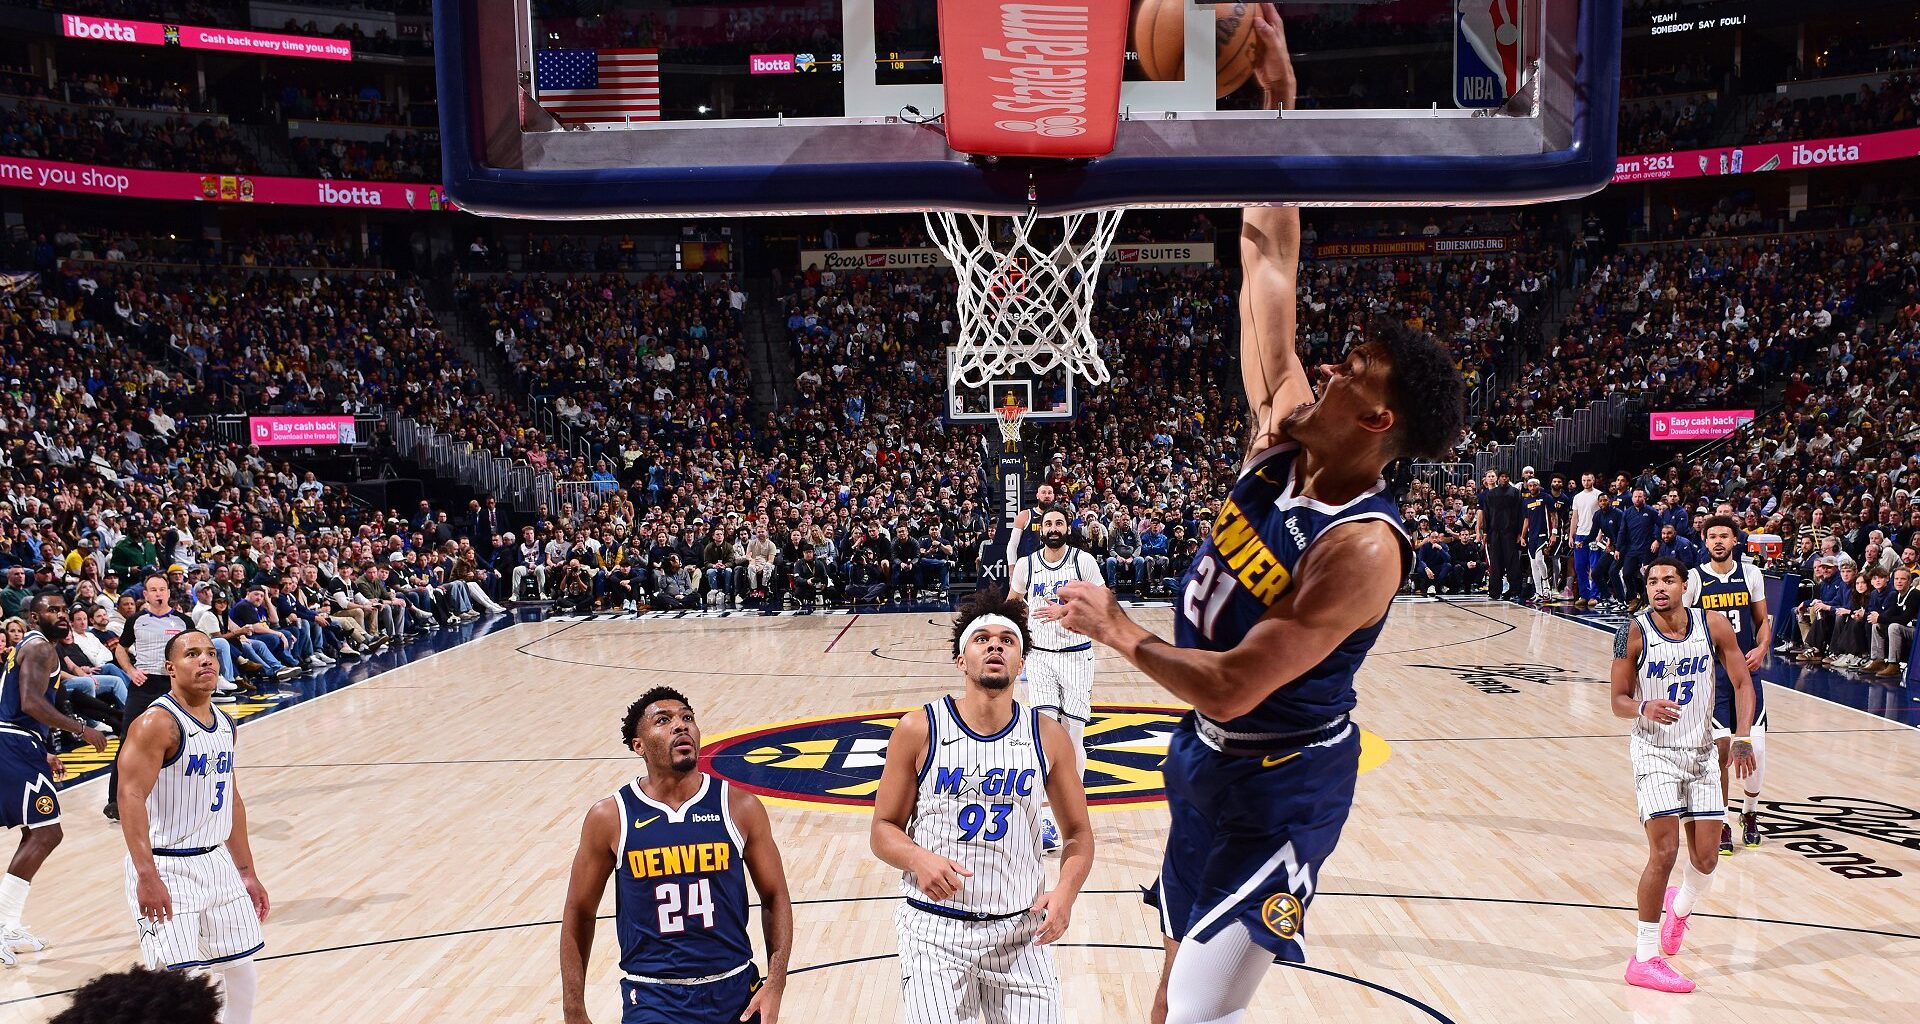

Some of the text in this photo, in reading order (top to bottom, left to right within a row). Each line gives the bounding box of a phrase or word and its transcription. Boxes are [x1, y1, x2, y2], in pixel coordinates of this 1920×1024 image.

[1651, 12, 1678, 24] YEAH!
[67, 16, 136, 42] ibotta
[1651, 22, 1695, 35] SOMEBODY
[1698, 20, 1716, 29] SAY
[199, 33, 350, 57] Cash back every time you shop
[831, 54, 842, 62] 32
[889, 52, 899, 60] 91
[753, 58, 791, 72] ibotta
[831, 63, 842, 72] 25
[890, 62, 905, 70] 108
[1463, 76, 1495, 100] NBA
[1792, 144, 1859, 165] ibotta
[1615, 155, 1675, 173] arn $261
[38, 167, 76, 189] you
[82, 169, 129, 194] shop
[1616, 173, 1631, 183] year
[1643, 170, 1671, 180] average
[318, 184, 382, 205] ibotta
[1141, 248, 1191, 260] SUITES
[1317, 245, 1348, 256] EDDIE'S
[1351, 244, 1370, 254] KIDS
[1373, 242, 1425, 253] FOUNDATION
[1435, 239, 1503, 251] EDDIESKIDS.ORG
[824, 252, 865, 267] Coors
[888, 253, 938, 265] SUITES
[273, 421, 337, 433] Easy cash back
[1655, 420, 1666, 432] ib
[1671, 416, 1734, 428] Easy cash back
[257, 425, 269, 437] ib
[1700, 427, 1709, 435] the
[1005, 473, 1018, 529] UMB
[1284, 515, 1308, 551] ibotta
[1183, 555, 1238, 641] 21
[1701, 591, 1750, 609] DENVER
[1667, 680, 1696, 706] 13
[210, 781, 226, 812] 3
[692, 813, 721, 823] ibotta
[956, 803, 1014, 842] 93
[627, 842, 731, 879] DENVER
[654, 877, 716, 934] 24
